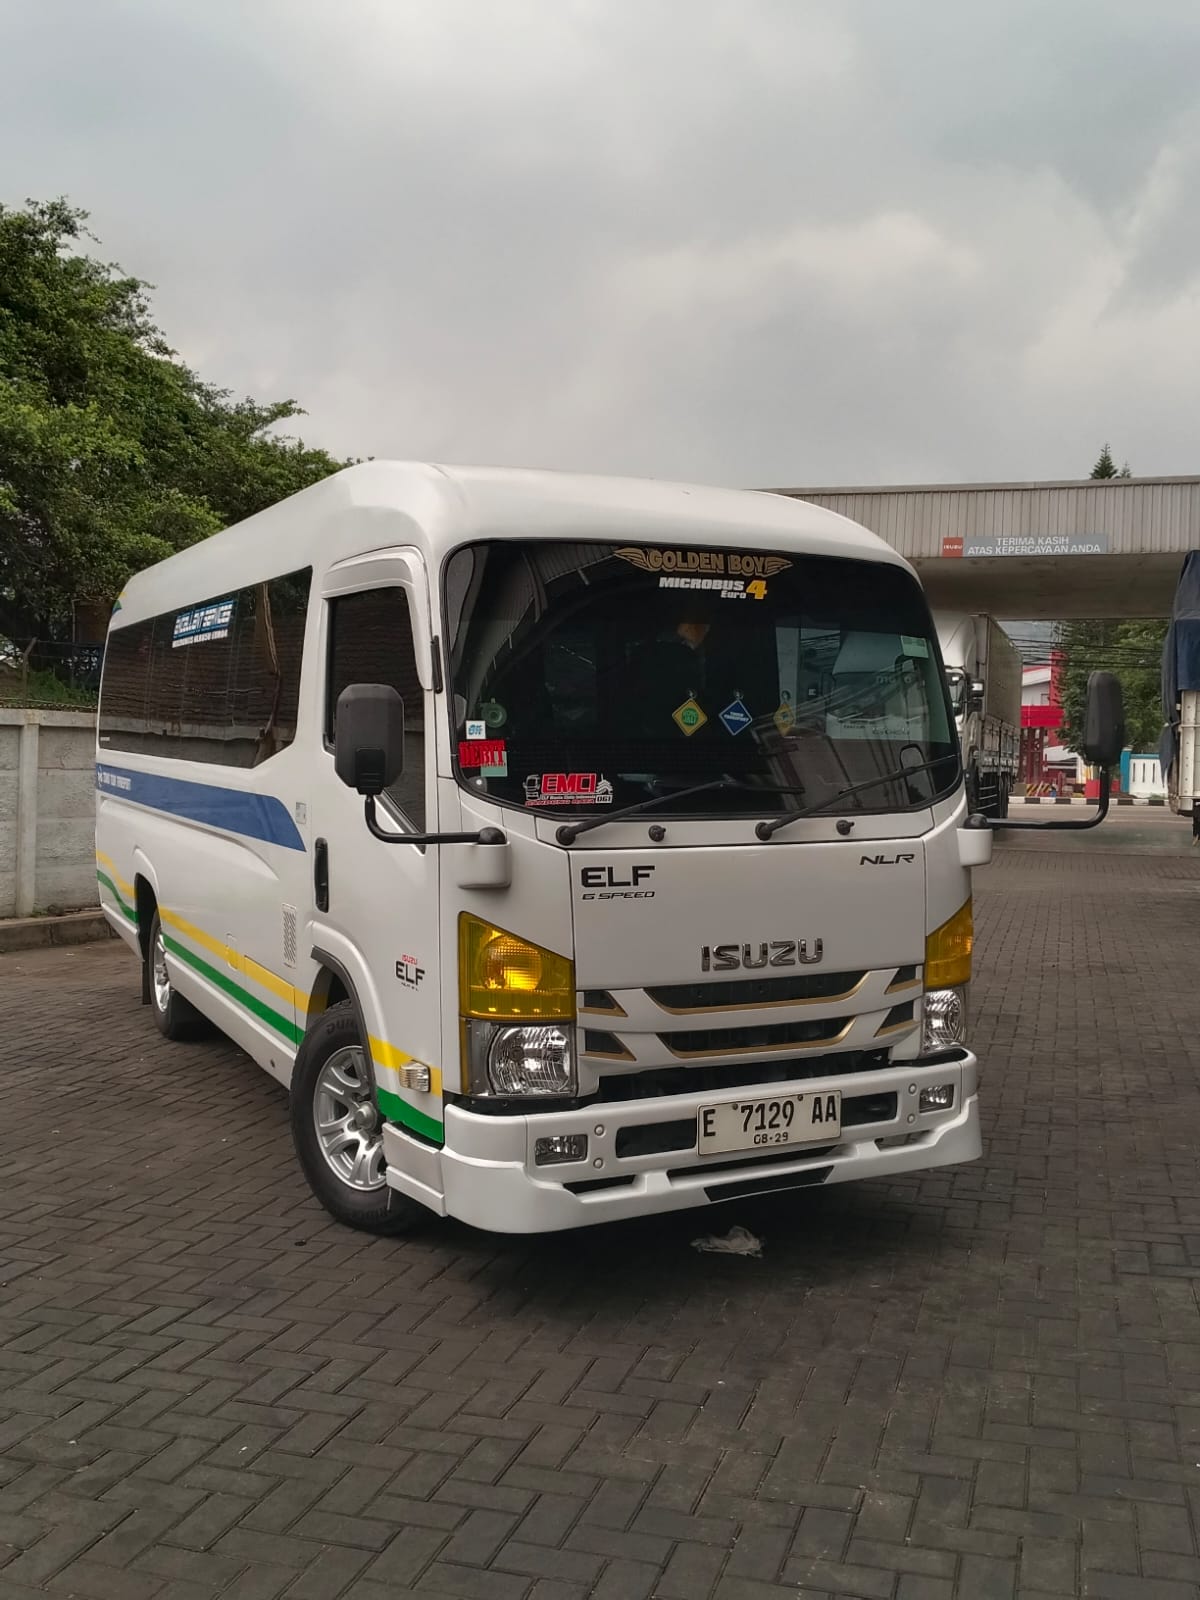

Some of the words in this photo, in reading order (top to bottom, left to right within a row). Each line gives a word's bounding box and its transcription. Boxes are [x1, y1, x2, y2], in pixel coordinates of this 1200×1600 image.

[967, 546, 993, 555] ATAS
[995, 544, 1069, 554] KEPERCAYAAN
[1071, 543, 1101, 553] ANDA
[997, 537, 1035, 547] TERIMA
[1037, 536, 1070, 546] KASIH
[649, 550, 725, 573] GOLDEN
[728, 554, 768, 576] BOY
[659, 577, 745, 591] MICROBUS
[720, 590, 747, 599] Euro
[746, 580, 768, 599] 4
[541, 773, 597, 794] EMCI
[859, 854, 915, 865] NLR
[581, 866, 655, 888] ELF
[598, 891, 655, 899] SPEED
[701, 938, 823, 971] ISUZU
[396, 960, 425, 986] ELF
[703, 1109, 716, 1137] E
[740, 1100, 795, 1132] 7129
[812, 1095, 837, 1124] AA
